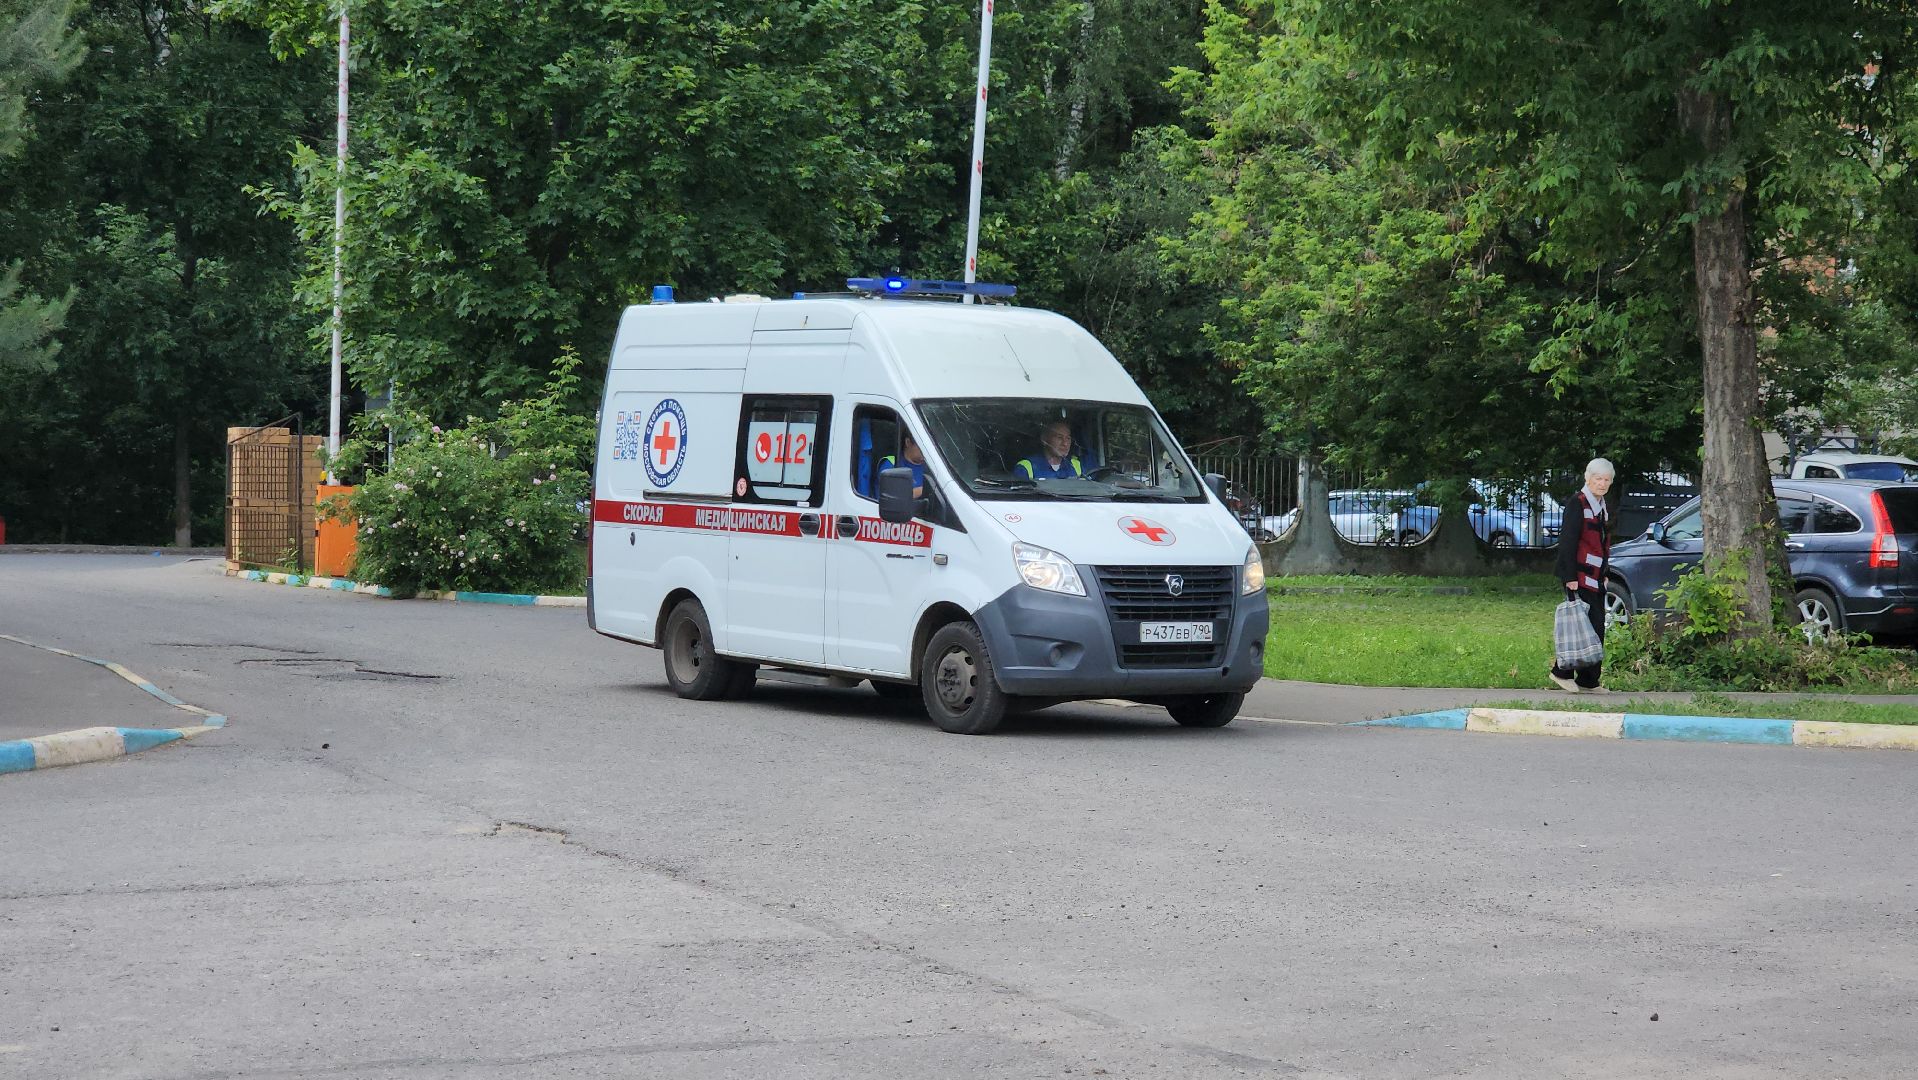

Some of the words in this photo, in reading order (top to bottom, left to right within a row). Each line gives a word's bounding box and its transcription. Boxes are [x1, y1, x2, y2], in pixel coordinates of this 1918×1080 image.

[646, 401, 667, 434] СКОРАЯ
[668, 400, 687, 436] ПОМОЩЬ
[643, 443, 668, 486] МОСКОВСКАЯ
[666, 445, 686, 483] ОБЛАСТЬ
[773, 433, 807, 464] 112
[623, 504, 664, 523] СКОРАЯ
[695, 509, 786, 532] МЕДИЦИНСКАЯ
[861, 519, 925, 546] ПОМОЩЬ
